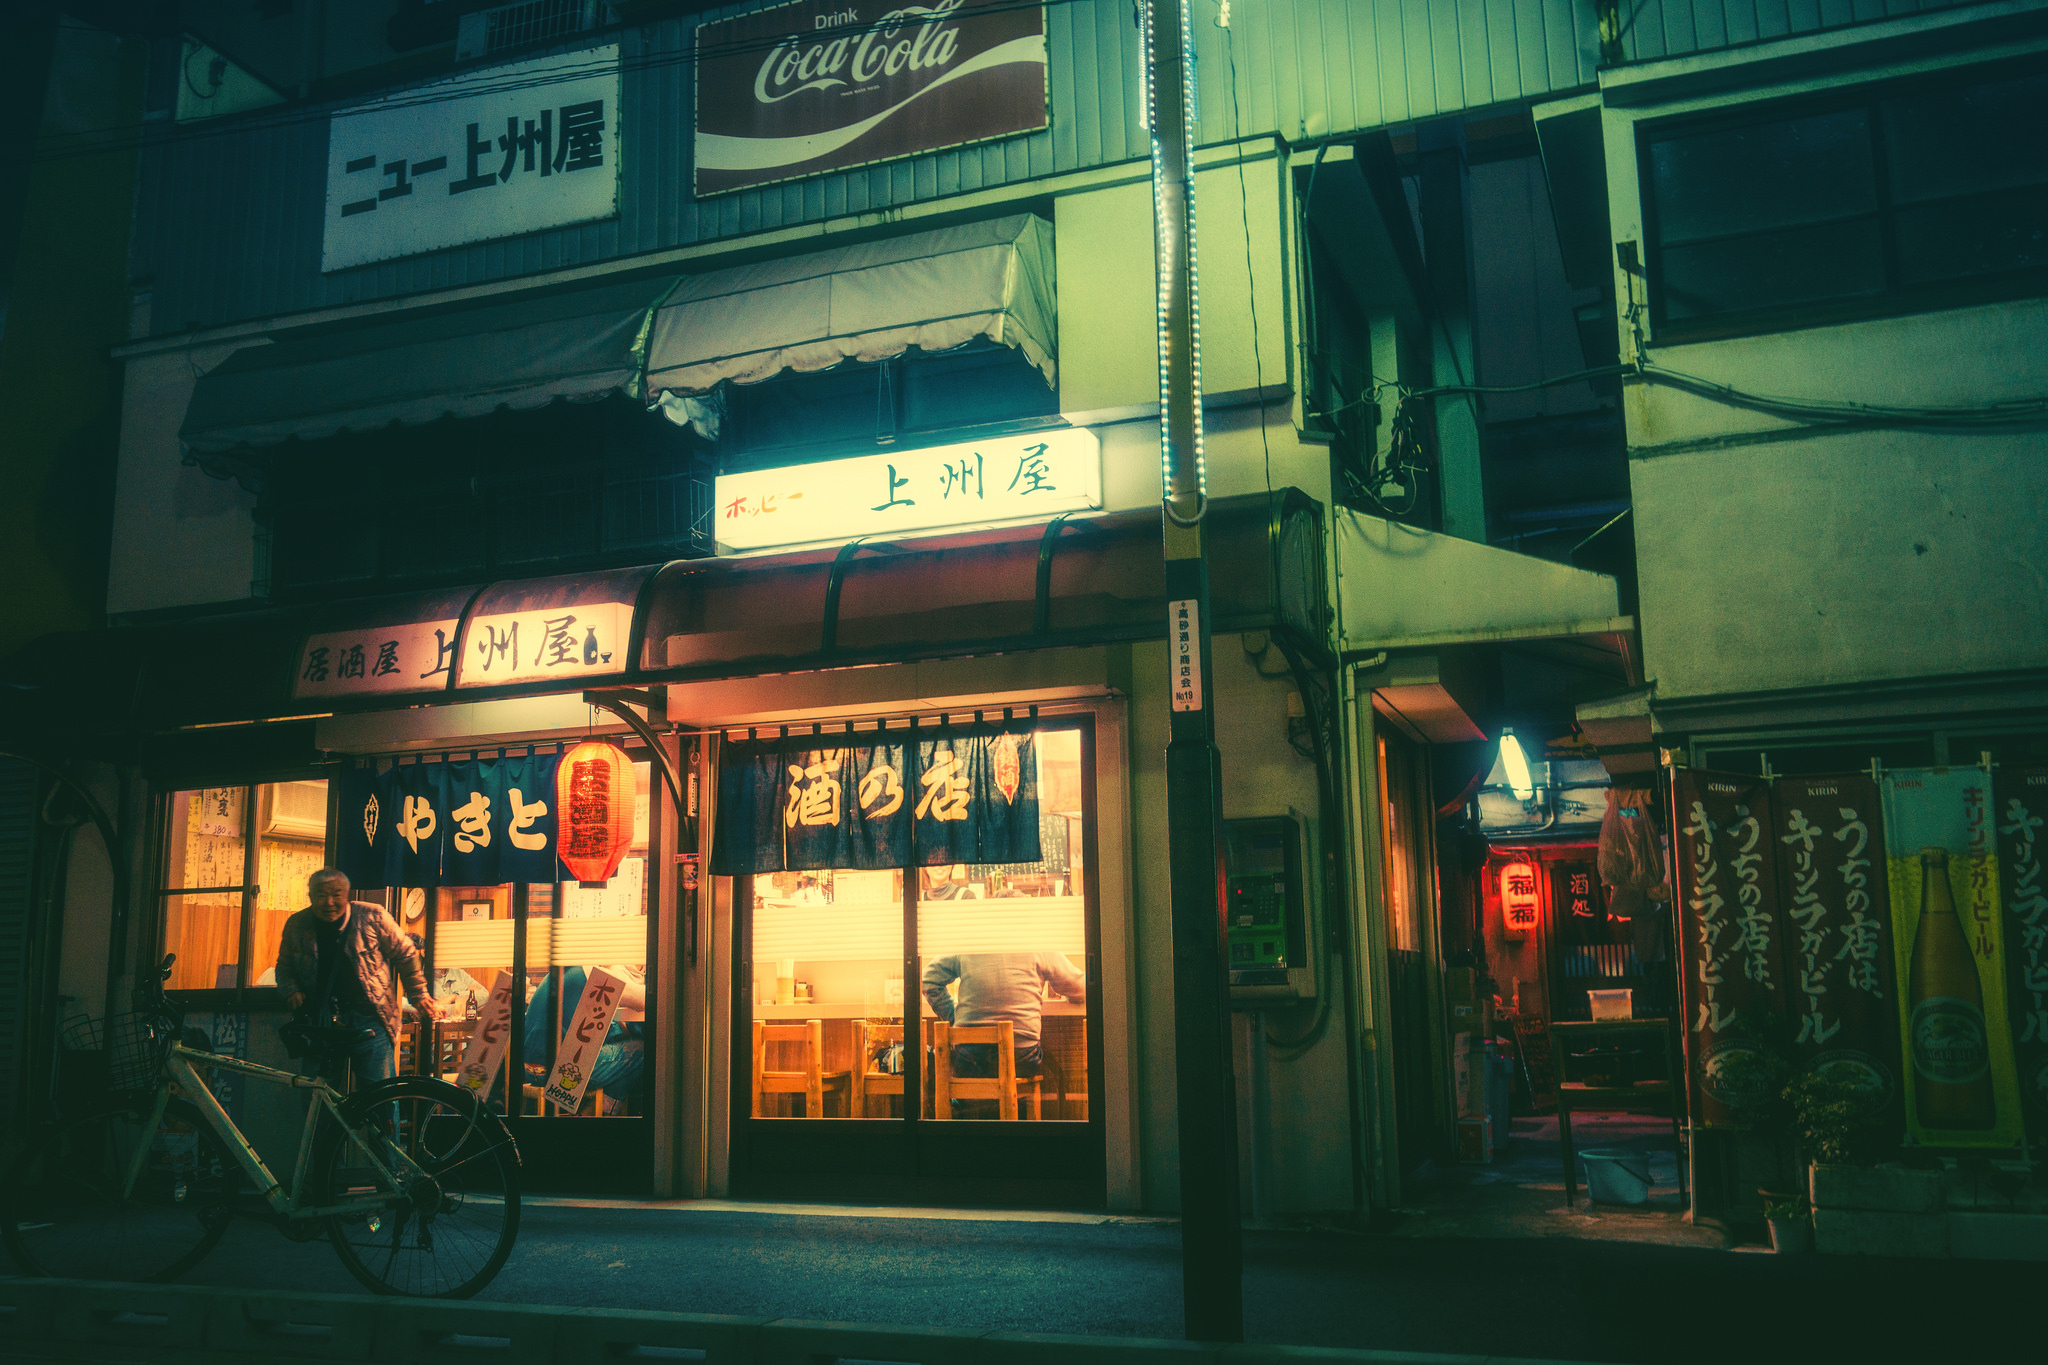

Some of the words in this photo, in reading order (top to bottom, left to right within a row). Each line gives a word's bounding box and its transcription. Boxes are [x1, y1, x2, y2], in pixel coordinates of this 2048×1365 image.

[754, 0, 963, 104] Coca-Cola
[815, 7, 858, 29] Drink
[341, 99, 605, 217] ニュー上州屋
[725, 492, 803, 518] ホッピー
[871, 442, 1056, 512] 上州屋
[302, 640, 401, 683] 居酒屋
[420, 614, 579, 679] 上州屋
[786, 750, 971, 828] 酒の店
[1707, 783, 1737, 793] KIRIN
[1807, 786, 1838, 796] KIRIN
[1894, 780, 1923, 789] KIRIN
[1508, 873, 1535, 923] 福福
[1570, 873, 1594, 917] 酒処
[1682, 800, 1736, 1033] キリンラガービール
[1726, 803, 1776, 991] うちの店は、
[1780, 808, 1841, 1044] キリンラガービール
[1832, 807, 1884, 999] うちの店は、
[572, 977, 616, 1064] ホッピー
